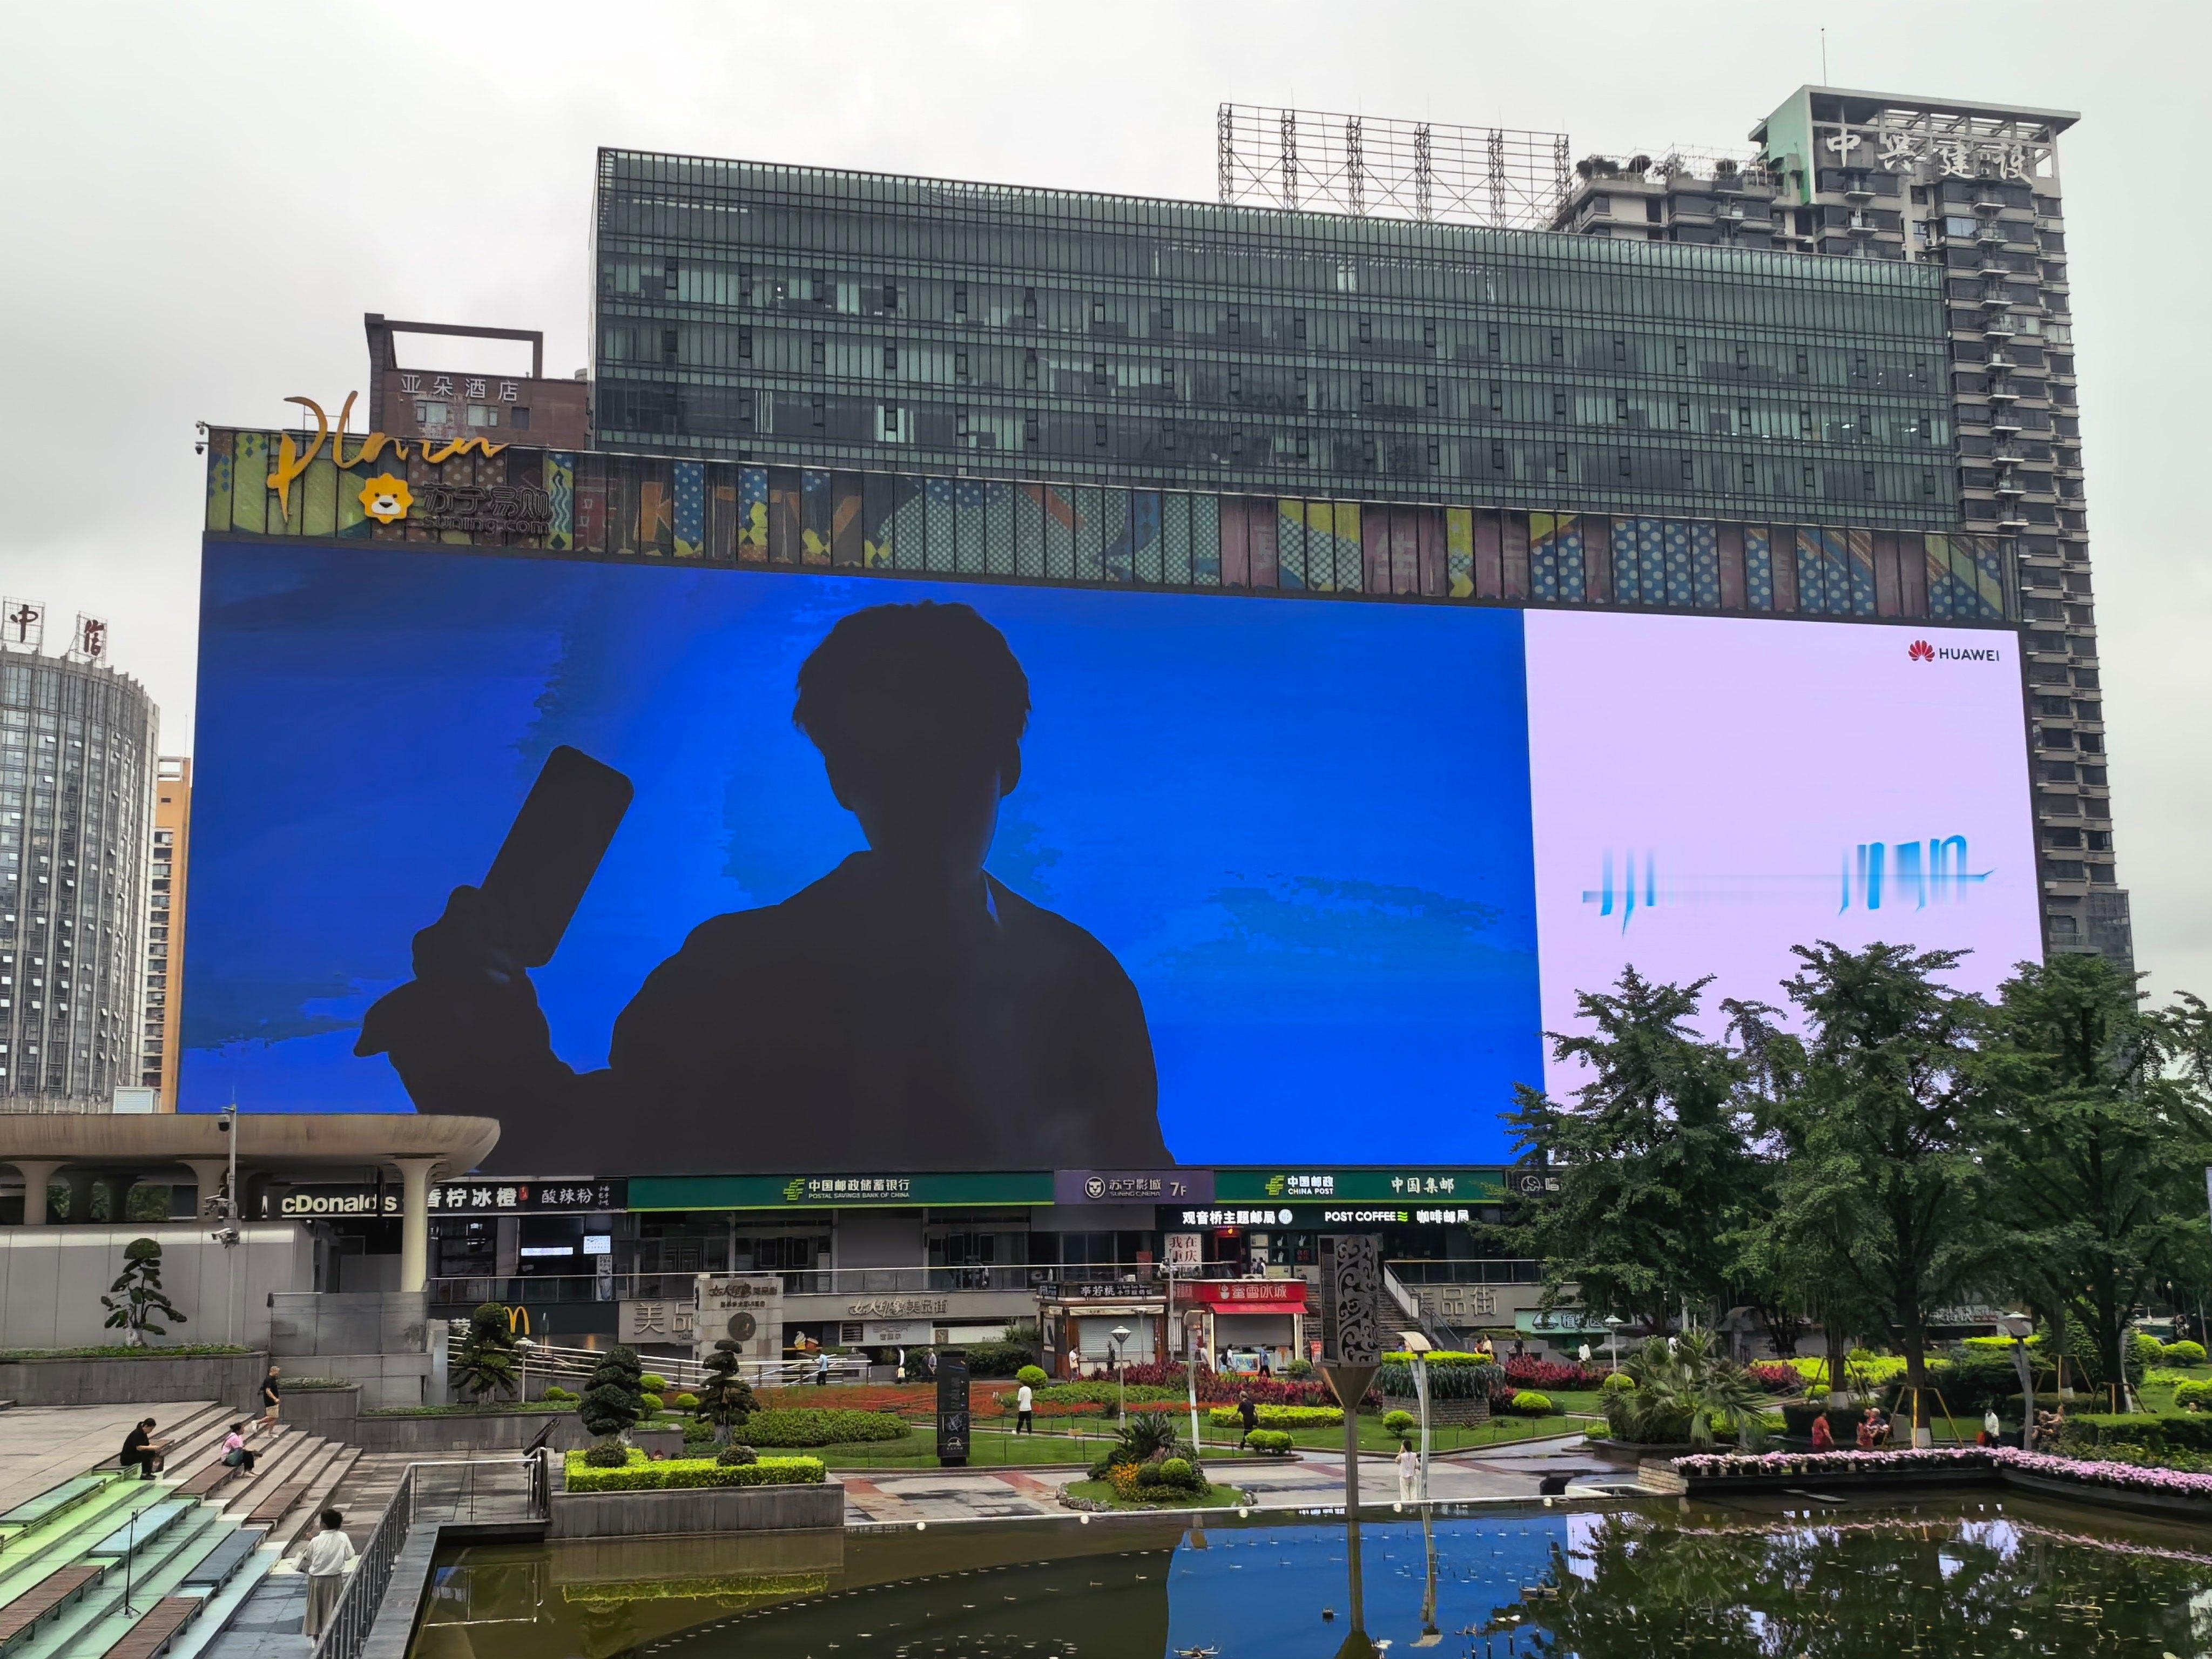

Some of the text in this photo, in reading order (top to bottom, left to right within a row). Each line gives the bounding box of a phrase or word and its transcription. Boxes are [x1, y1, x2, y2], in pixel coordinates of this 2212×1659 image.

[1826, 127, 2032, 185] 中兴建设
[401, 374, 518, 402] 亚朵酒店
[423, 483, 551, 517] 苏宁易购
[423, 516, 551, 534] suning.com
[1939, 648, 1999, 662] HUAWEI
[808, 1179, 910, 1192] 中国邮政储蓄银行
[1109, 1178, 1161, 1191] 苏宁影城
[1287, 1175, 1334, 1188] 中国邮政
[1391, 1176, 1455, 1194] 中国集邮
[542, 1188, 594, 1204] 酸辣粉
[1170, 1182, 1187, 1196] 7F
[1182, 1210, 1276, 1224] 观音桥主题邮局
[1325, 1209, 1469, 1224] POST COFFEE 咖啡邮局
[1169, 1236, 1197, 1249] 我在
[1170, 1250, 1197, 1263] 重庆
[1232, 1284, 1287, 1299] 蜜雪冰城
